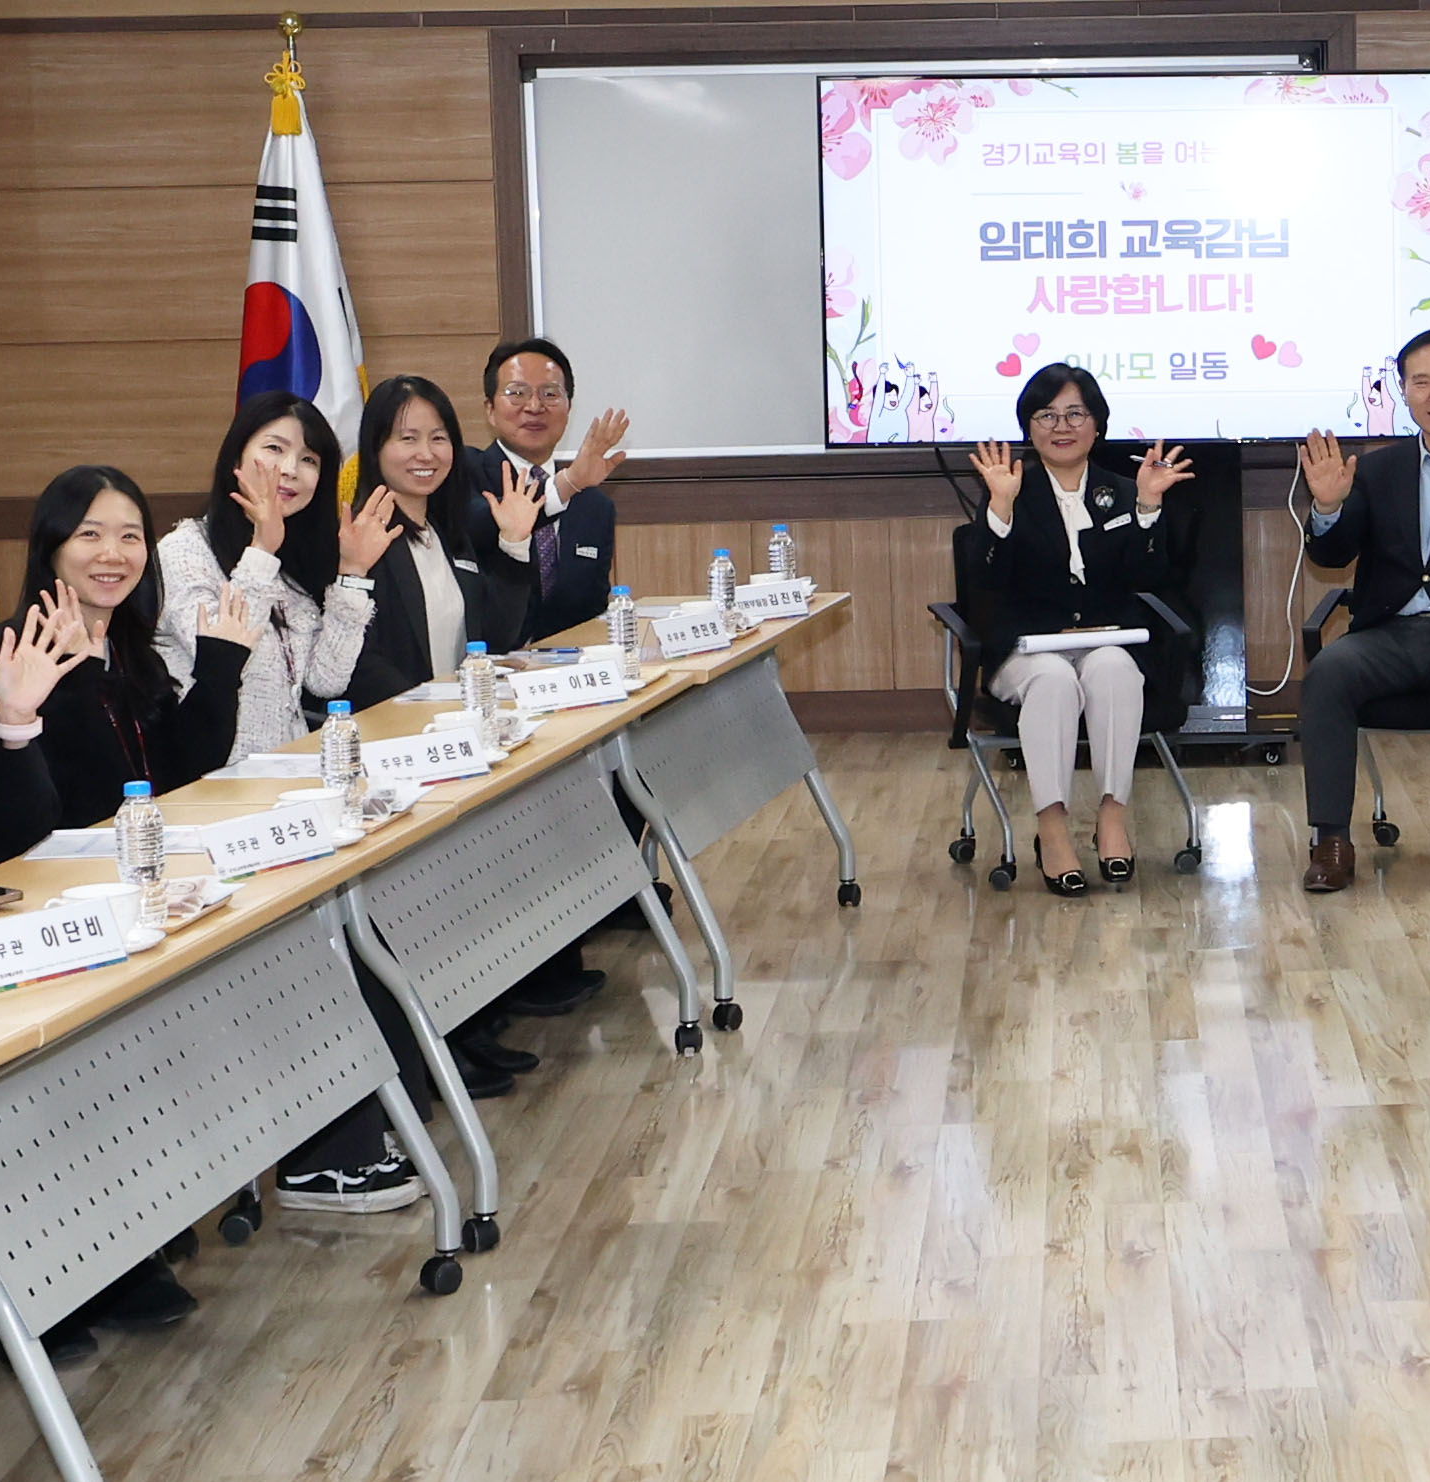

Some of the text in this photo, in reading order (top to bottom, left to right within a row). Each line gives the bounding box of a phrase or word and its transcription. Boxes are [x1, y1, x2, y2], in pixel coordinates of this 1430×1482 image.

[981, 141, 1106, 167] 경기교육의
[1116, 141, 1165, 165] 봄을
[979, 218, 1289, 262] 임태희 교육감님
[1025, 273, 1255, 316] 사랑합니다!
[1169, 351, 1230, 382] 일동
[568, 670, 613, 690] 이재은
[379, 740, 475, 771] 주무관 성은혜
[225, 836, 262, 856] 주무관
[269, 817, 318, 846] 장수정
[40, 914, 105, 949] 이단비
